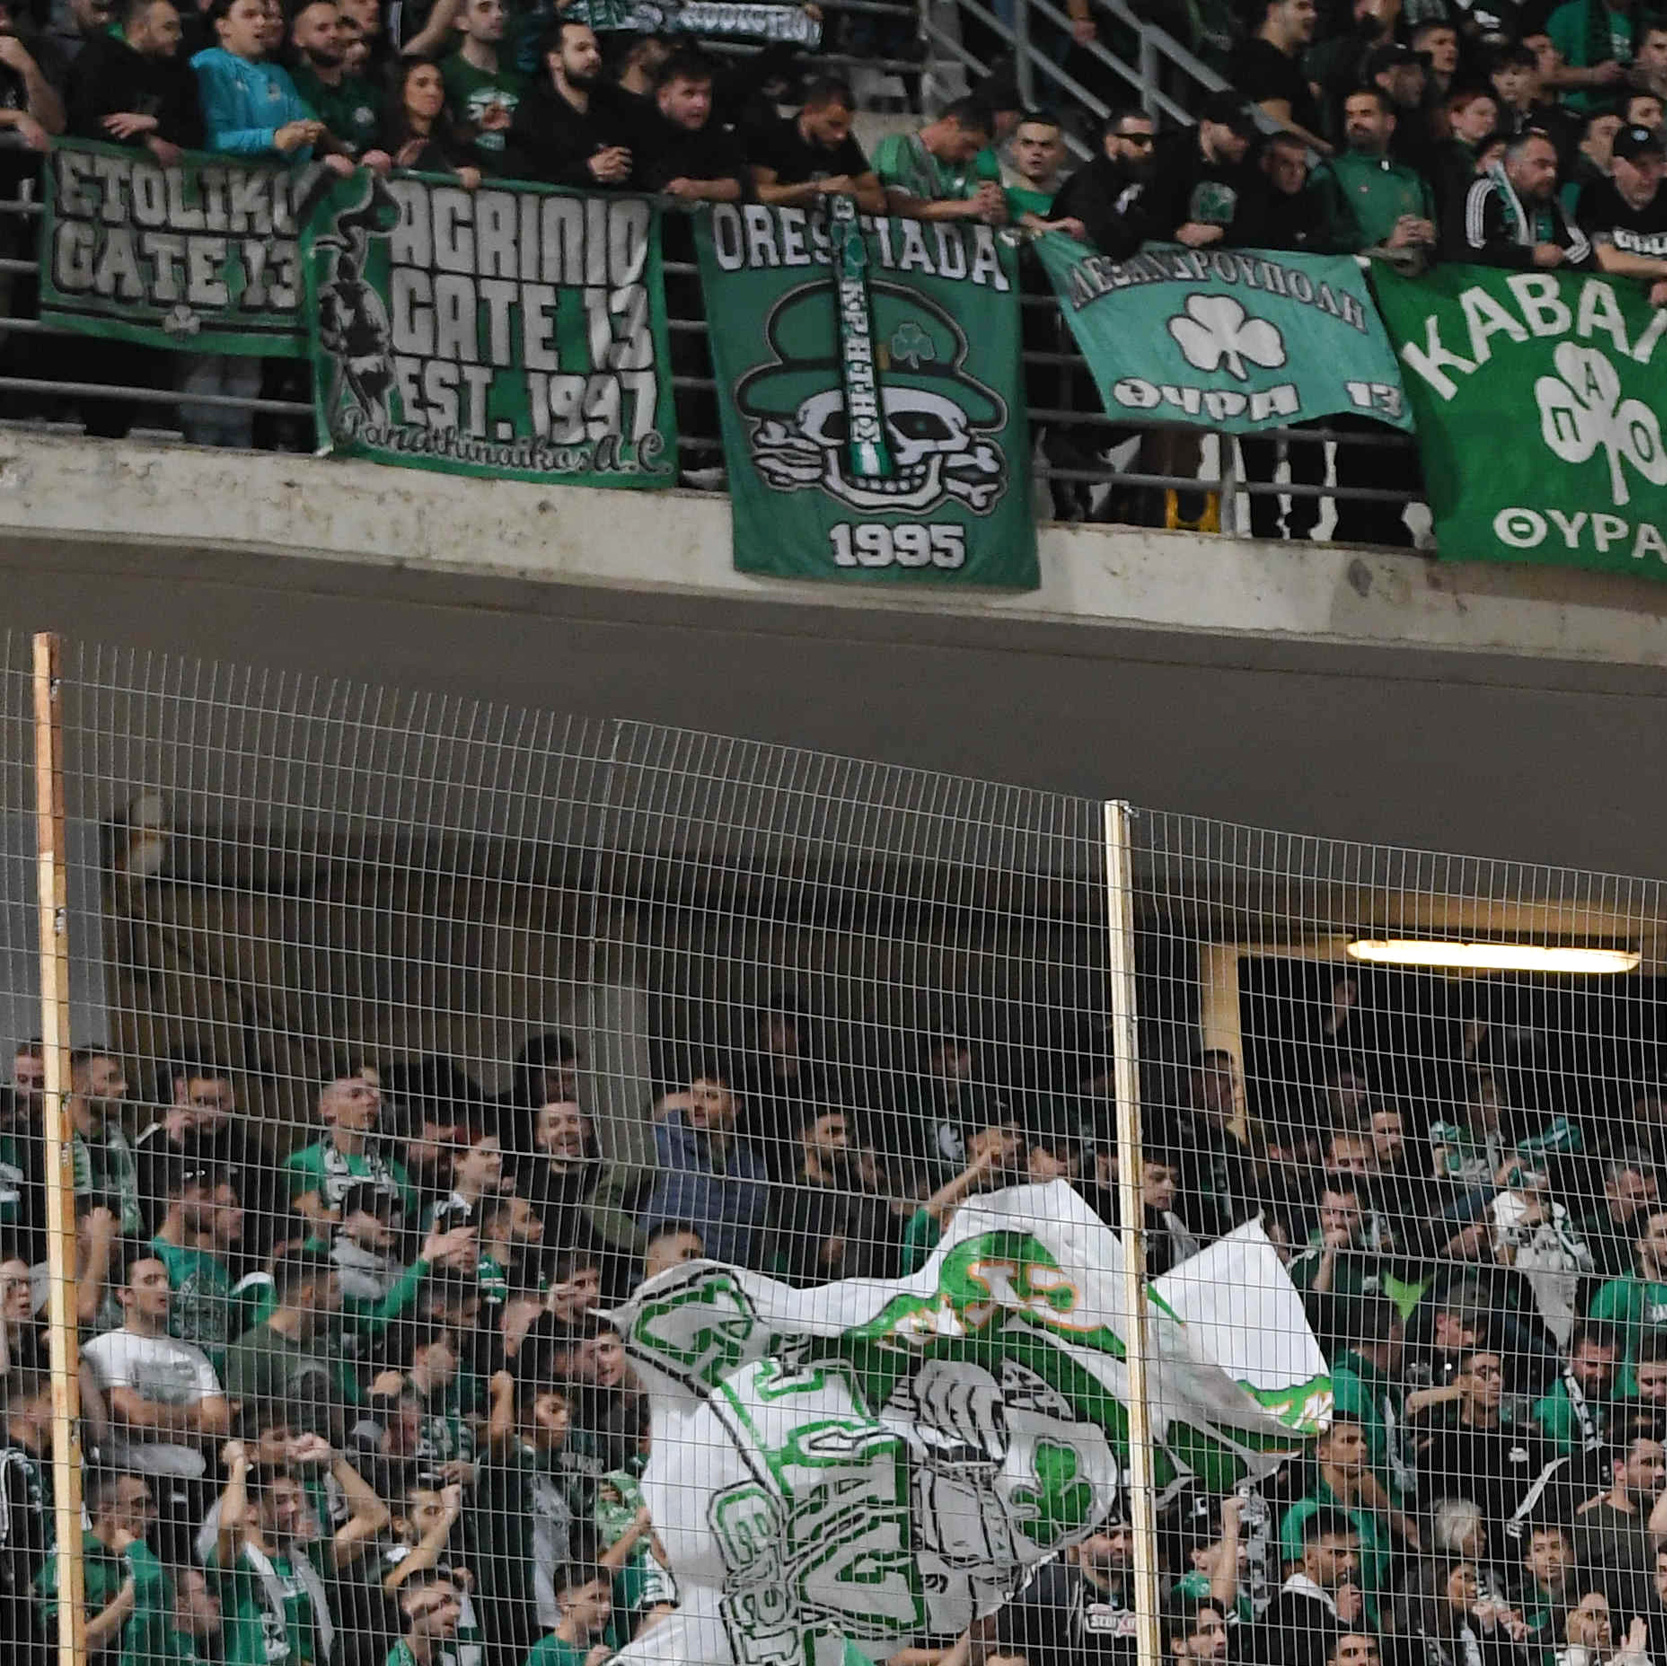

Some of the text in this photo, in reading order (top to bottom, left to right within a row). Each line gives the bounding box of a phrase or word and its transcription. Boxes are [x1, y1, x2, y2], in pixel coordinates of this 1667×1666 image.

[54, 220, 299, 308] GATE 13
[390, 181, 650, 286] AGRINIO
[713, 203, 1010, 292] ORESIADA
[392, 266, 655, 371] GATE 13
[398, 356, 515, 440] EST.
[1345, 381, 1403, 418] 13
[829, 522, 966, 569] 1995
